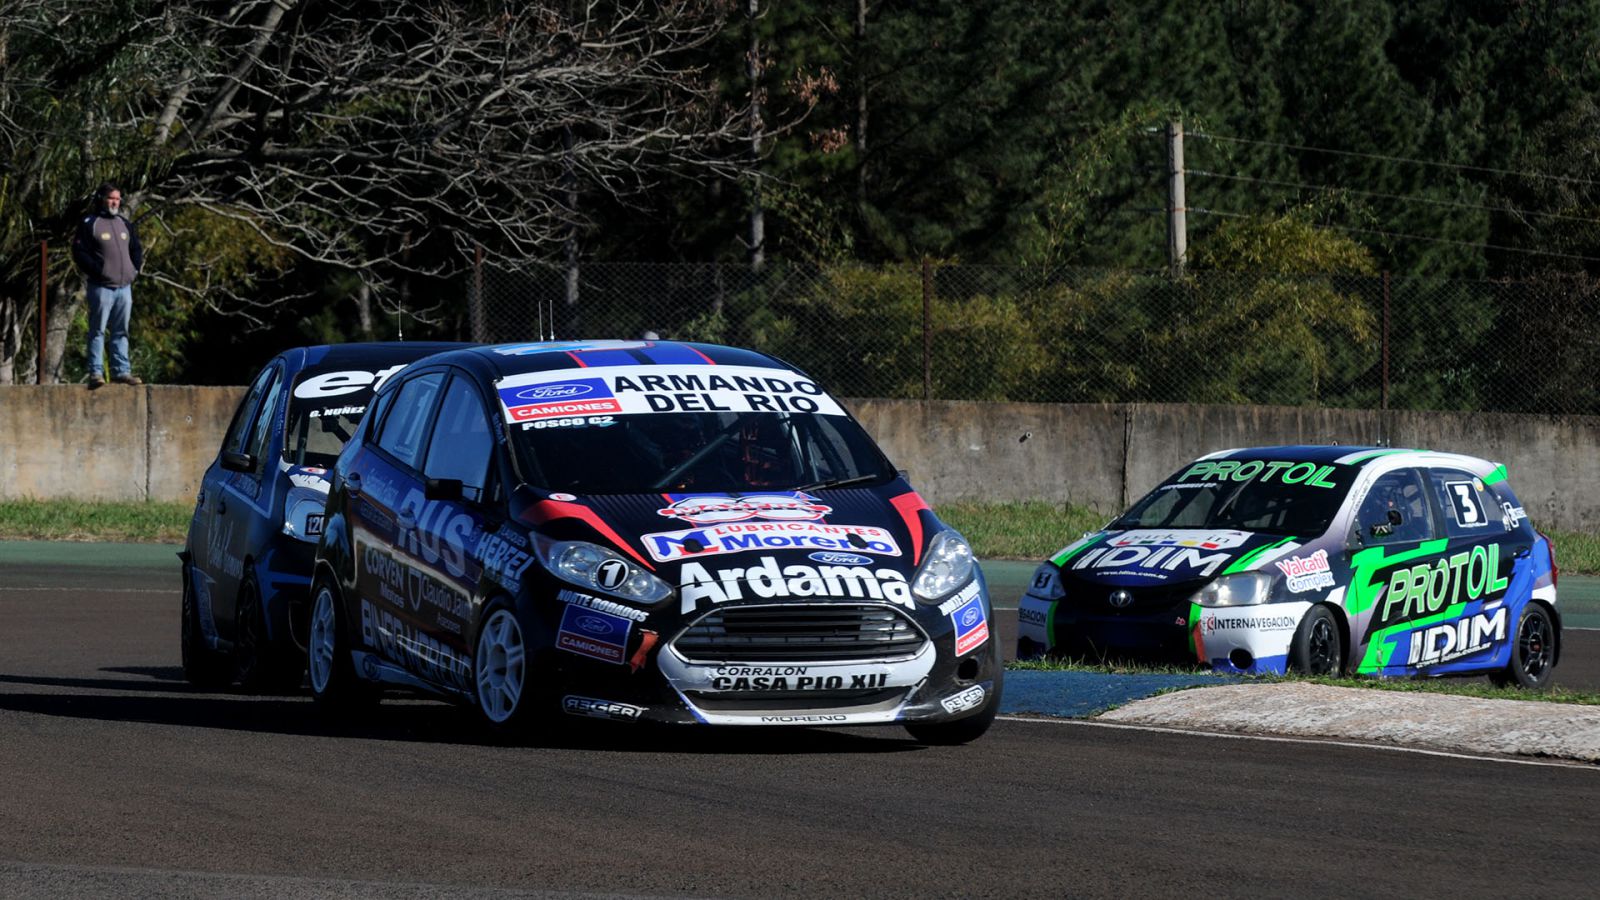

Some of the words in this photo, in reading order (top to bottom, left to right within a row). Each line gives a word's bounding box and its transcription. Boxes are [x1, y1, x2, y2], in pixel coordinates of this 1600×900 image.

[532, 387, 578, 398] Ford
[614, 374, 824, 396] ARMANDO
[517, 402, 616, 418] CAMIONES
[644, 393, 732, 413] DEL
[743, 394, 820, 413] RIO
[521, 417, 585, 431] POSCO
[1454, 485, 1478, 523] 3
[714, 523, 882, 537] LUBRICANTES
[822, 553, 861, 565] Ford
[1278, 551, 1329, 577] Valcatil
[602, 563, 622, 587] 1
[1286, 574, 1335, 592] Complex
[680, 556, 917, 616] Ardama
[561, 636, 620, 658] CAMIONES
[712, 676, 788, 691] CASA
[798, 675, 843, 690] PIO
